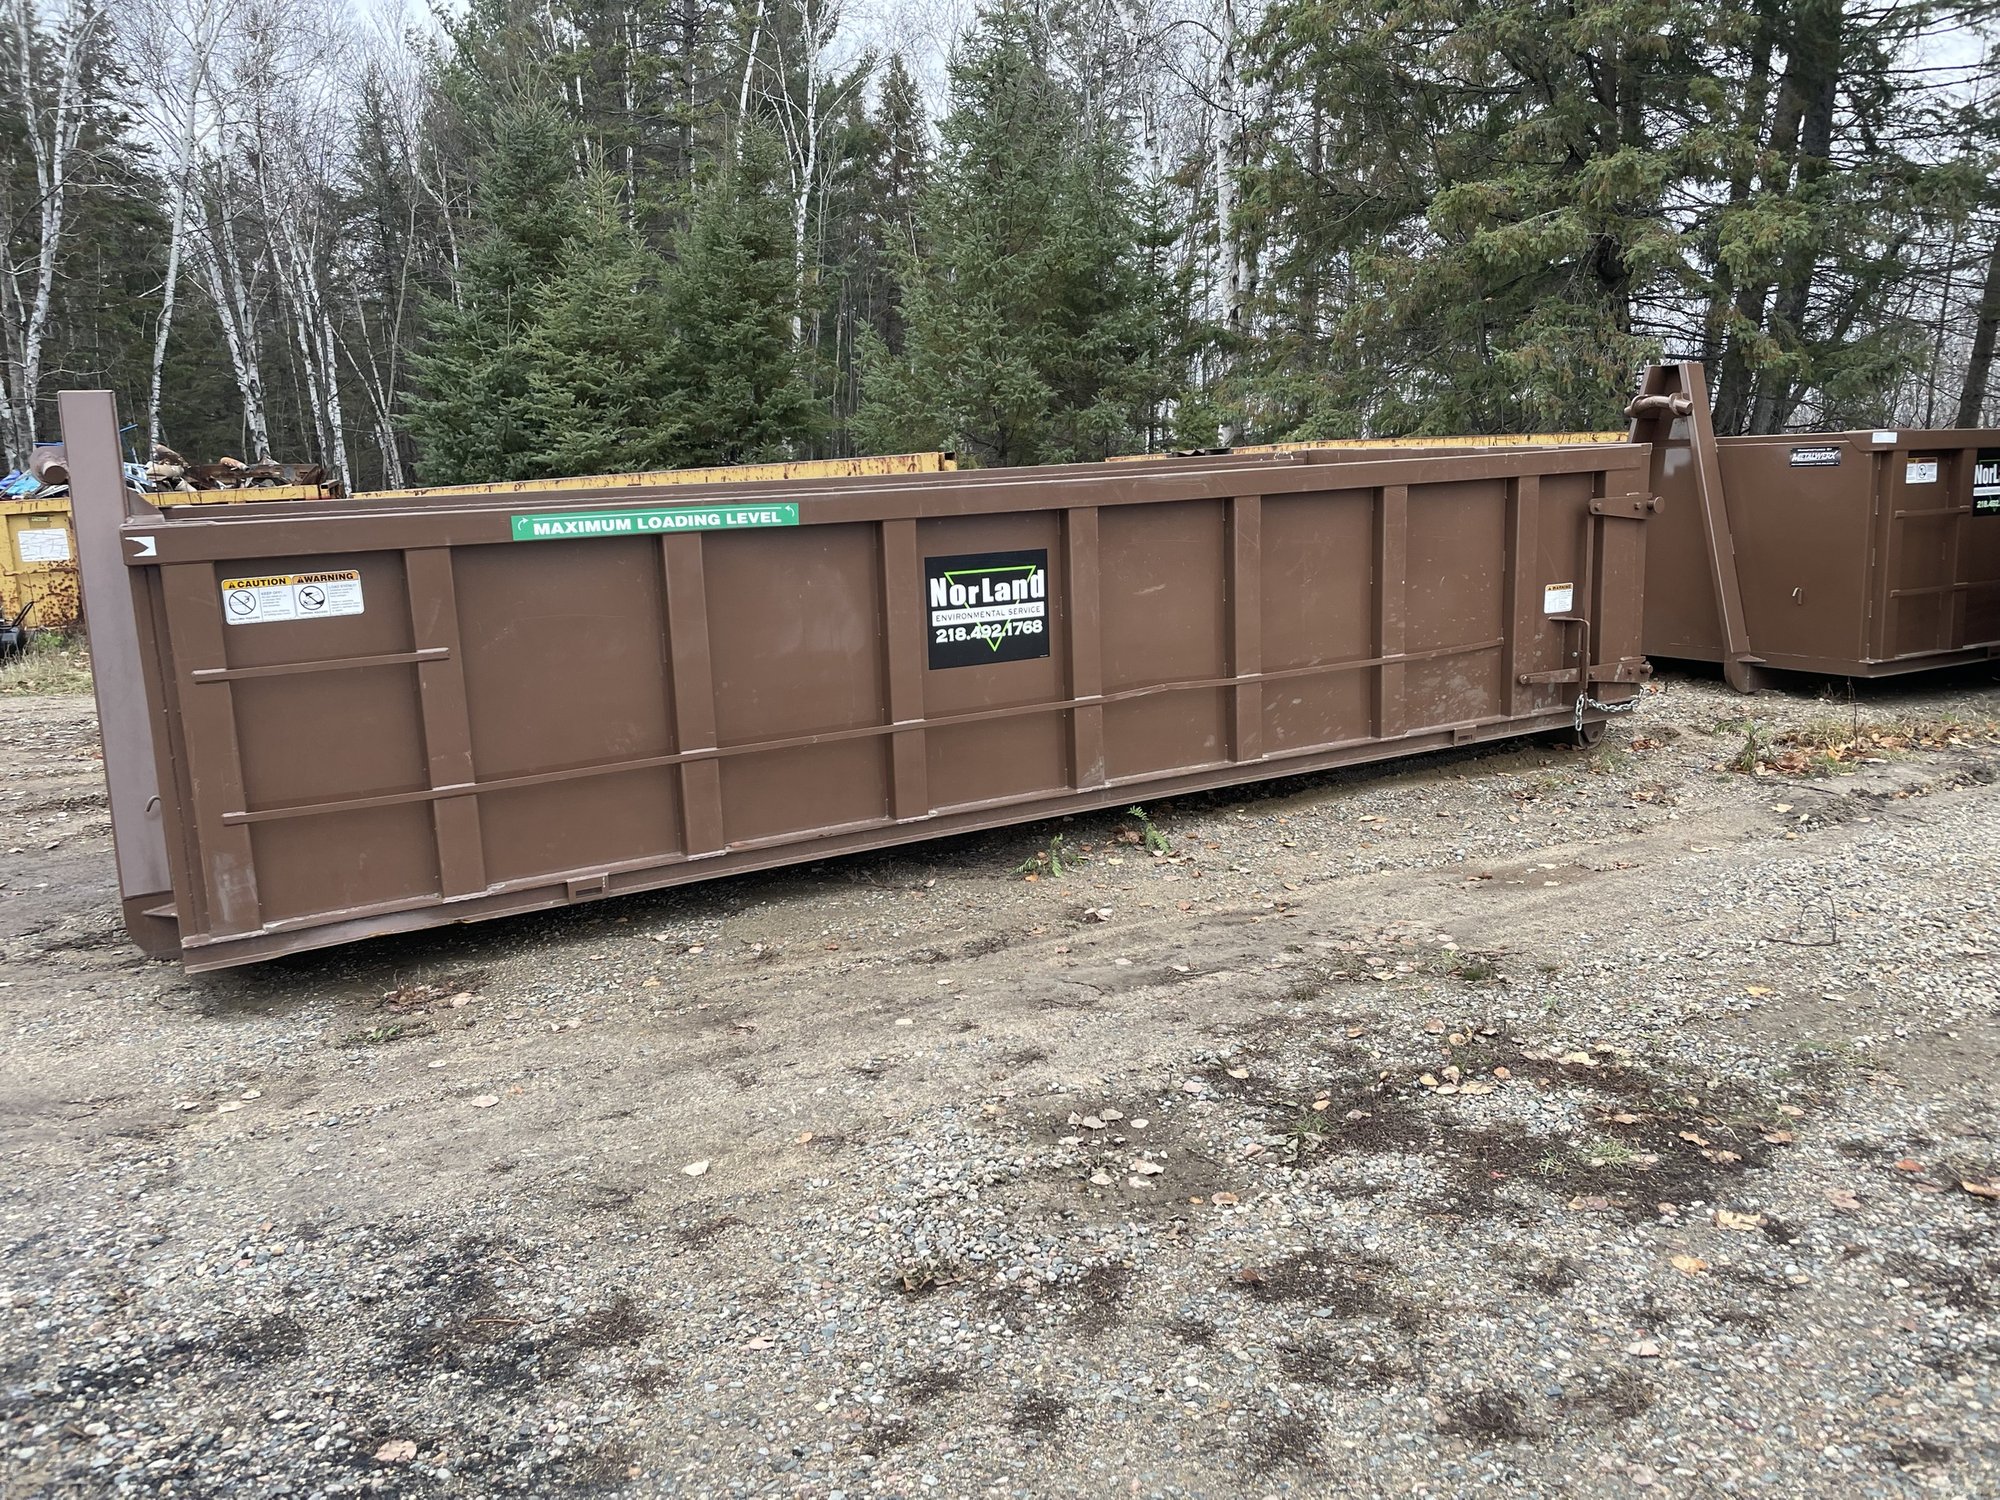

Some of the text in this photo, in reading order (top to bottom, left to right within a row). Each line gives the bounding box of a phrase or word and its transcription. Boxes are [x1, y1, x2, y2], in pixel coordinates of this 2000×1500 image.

[1974, 463, 2000, 485] NorL
[533, 511, 782, 536] MAXIMUM LOADING LEVEL
[237, 577, 287, 589] CAUTION
[304, 572, 354, 583] WARNING
[930, 569, 1045, 608] NorLand
[935, 605, 1042, 623] ENVIRONMENTAL SERVICE
[935, 619, 1044, 644] 218.492.1768
